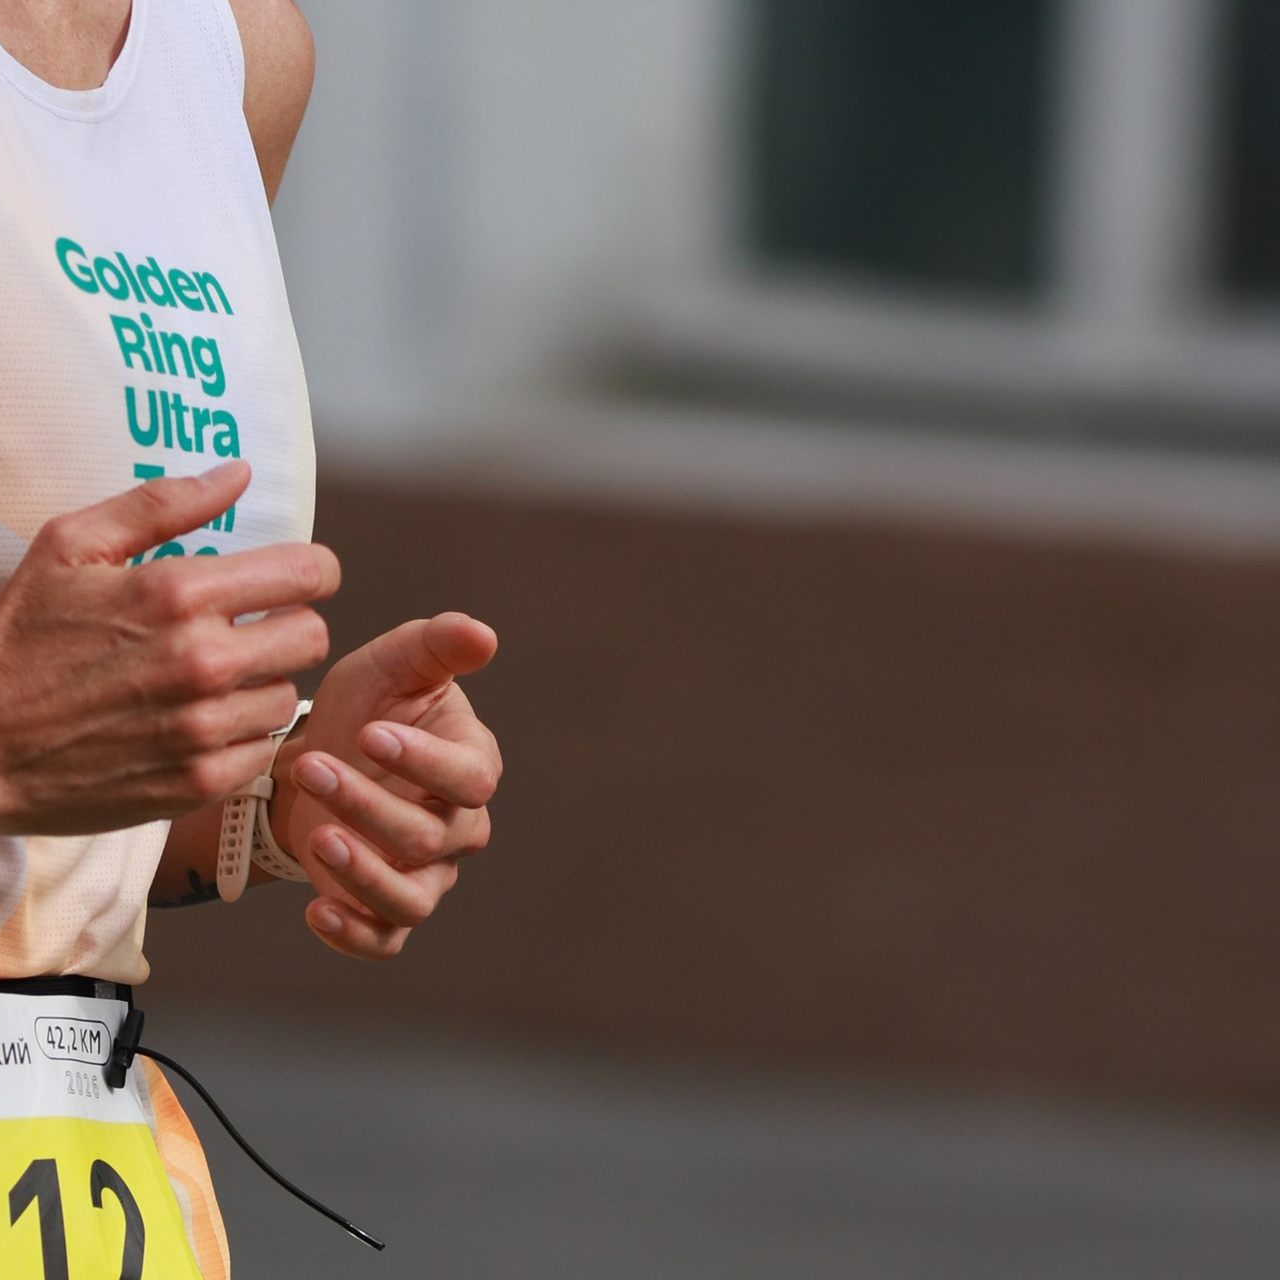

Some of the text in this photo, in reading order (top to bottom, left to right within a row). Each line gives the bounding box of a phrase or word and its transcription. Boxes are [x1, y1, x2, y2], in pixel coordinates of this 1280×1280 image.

[55, 237, 234, 316] Golden
[109, 312, 226, 398] Ring
[125, 386, 241, 458] Ultra
